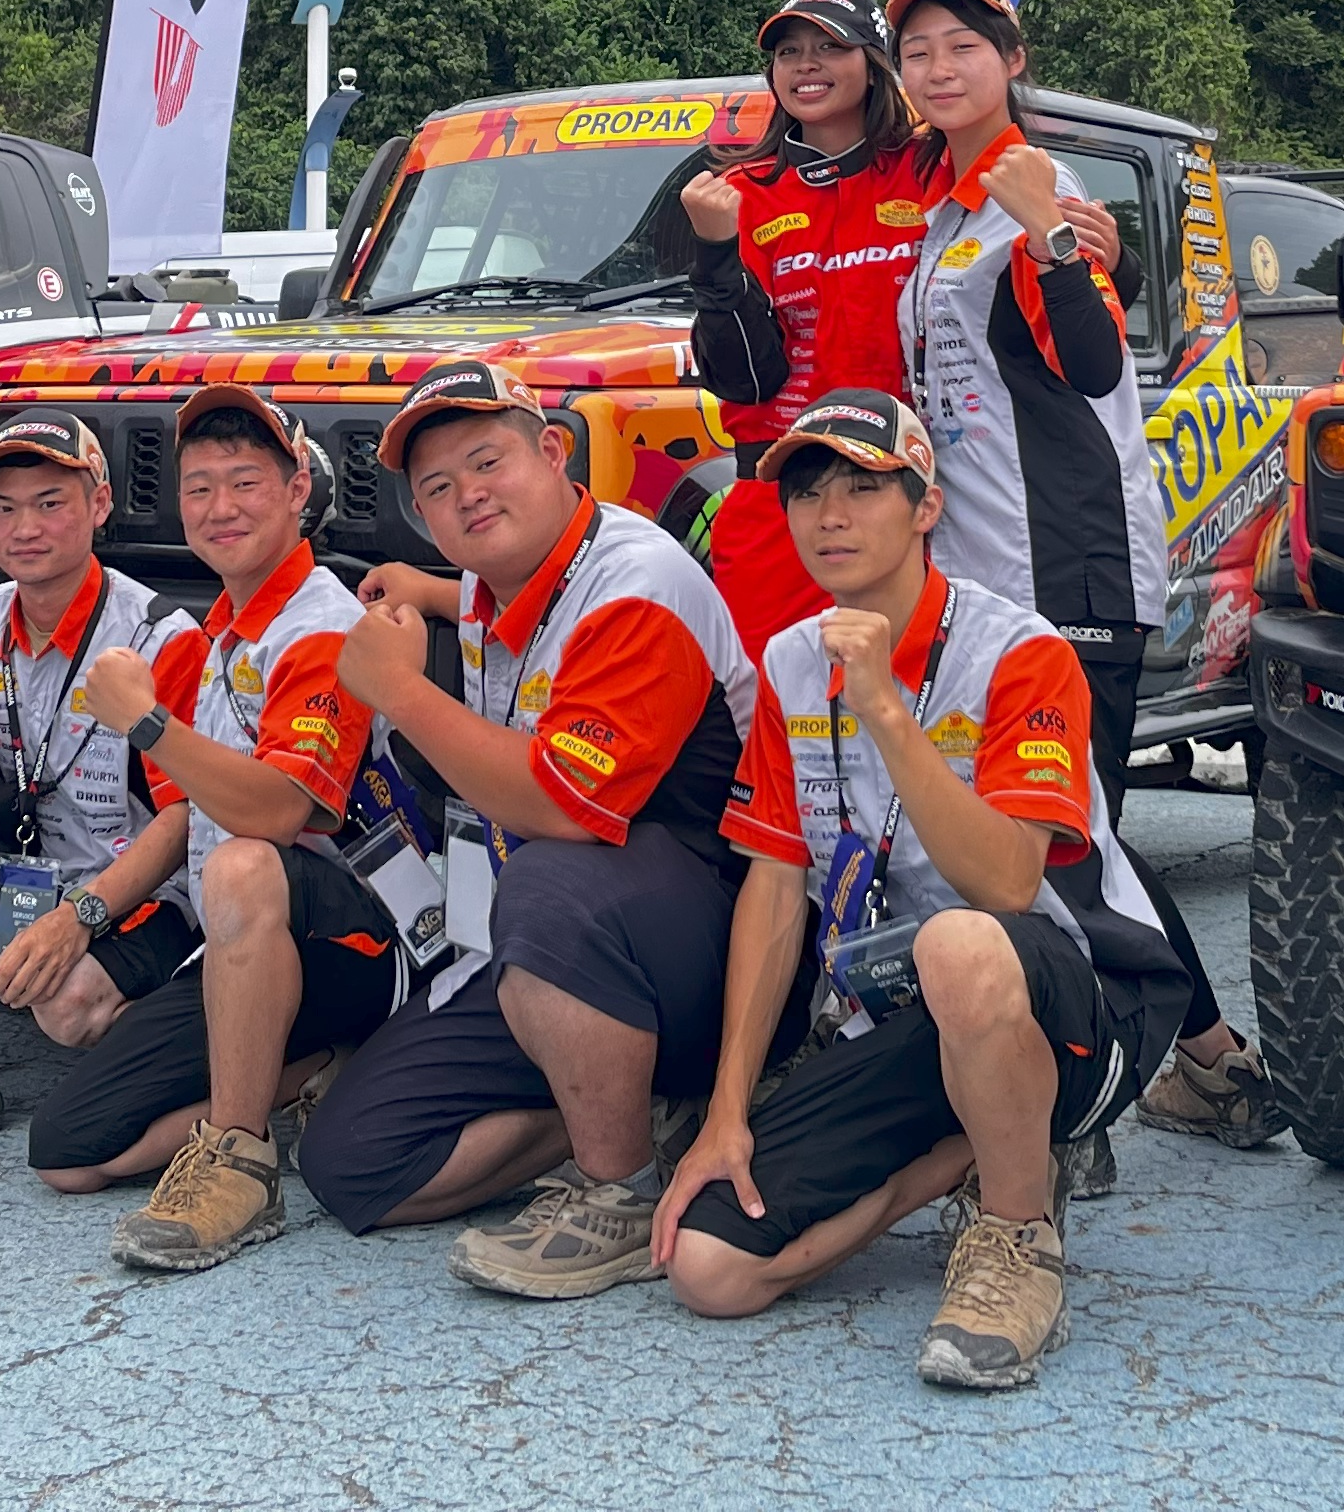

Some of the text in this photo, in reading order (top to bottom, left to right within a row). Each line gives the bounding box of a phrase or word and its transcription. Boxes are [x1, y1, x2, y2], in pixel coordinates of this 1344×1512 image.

[570, 107, 697, 136] PROPAK
[756, 215, 803, 243] PROPAK
[43, 275, 57, 294] E
[564, 538, 591, 581] YOKOHAMA
[790, 720, 850, 734] PROPK
[557, 735, 608, 771] PROPAK
